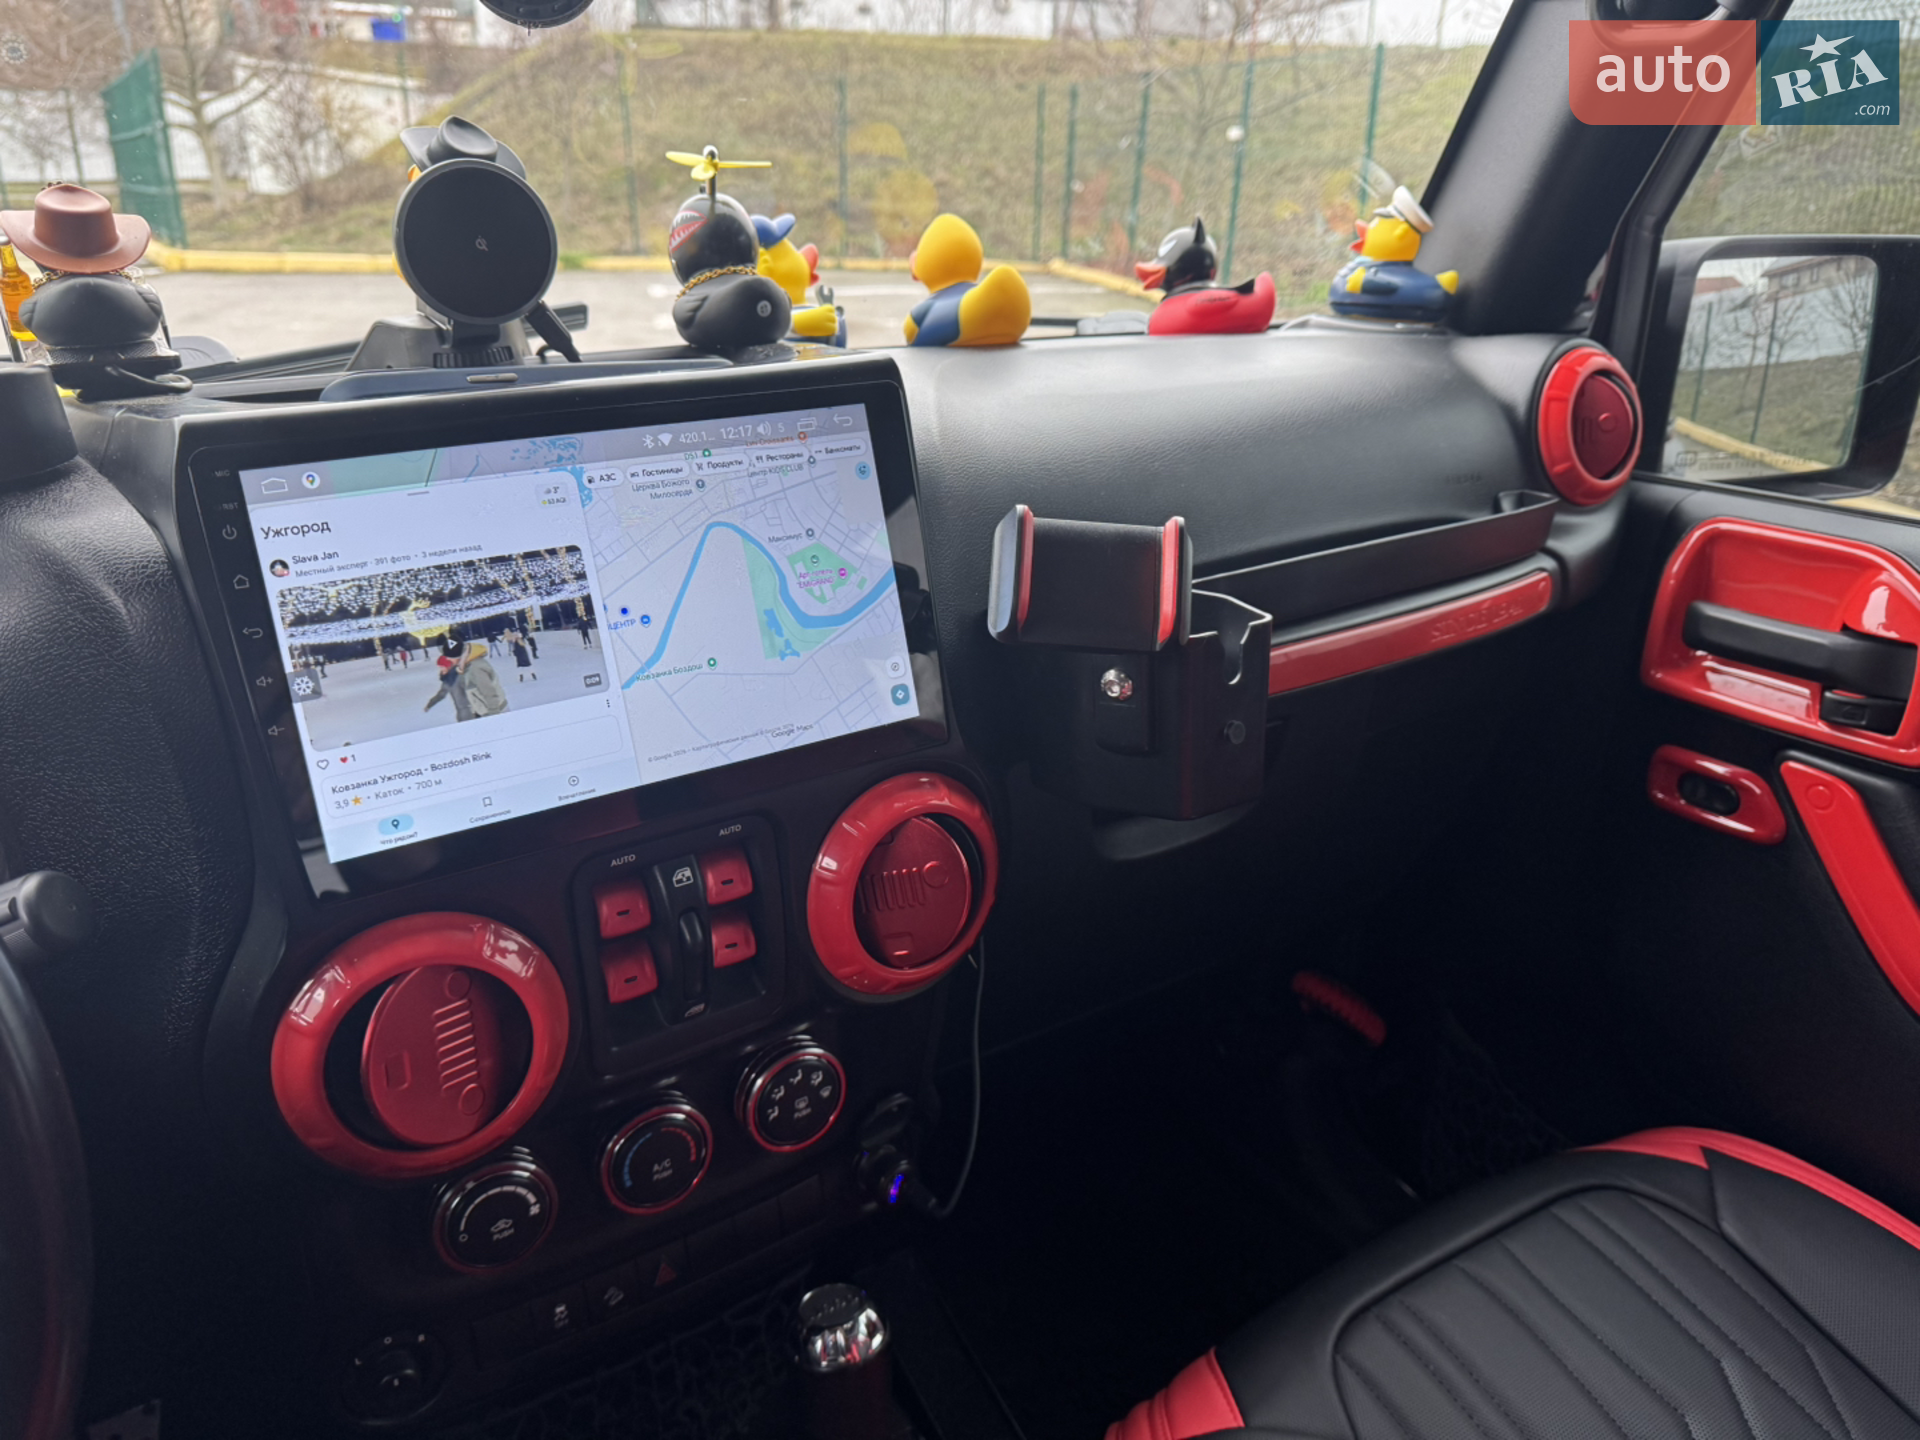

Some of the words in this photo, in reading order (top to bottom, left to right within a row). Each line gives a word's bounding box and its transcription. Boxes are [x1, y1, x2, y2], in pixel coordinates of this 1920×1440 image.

[720, 425, 752, 439] 12:17
[824, 444, 861, 454] Банкоматы
[766, 451, 804, 461] Рестораны
[707, 459, 744, 469] Продукты
[599, 473, 617, 482] АЗС
[642, 467, 683, 477] Гостиницы
[632, 482, 661, 492] Церква
[661, 479, 690, 488] Божого
[260, 521, 331, 540] Ужгород
[292, 555, 319, 565] Slava
[321, 551, 339, 561] Jan
[295, 565, 335, 578] Местный
[336, 559, 368, 572] эксперт
[390, 555, 411, 565] фото
[459, 544, 483, 553] назад
[636, 669, 673, 681] Ковзанка
[672, 664, 703, 674] Боздош
[351, 754, 357, 762] 1
[331, 778, 379, 795] Ковзанка
[379, 768, 424, 784] Ужгород
[430, 757, 471, 772] Bozdosh
[472, 751, 492, 763] Rink
[334, 799, 350, 810] 3,9
[374, 786, 405, 800] Каток
[415, 779, 433, 791] 700
[719, 824, 742, 836] AUTO
[610, 854, 636, 867] AUTO
[652, 1158, 672, 1173] A/C
